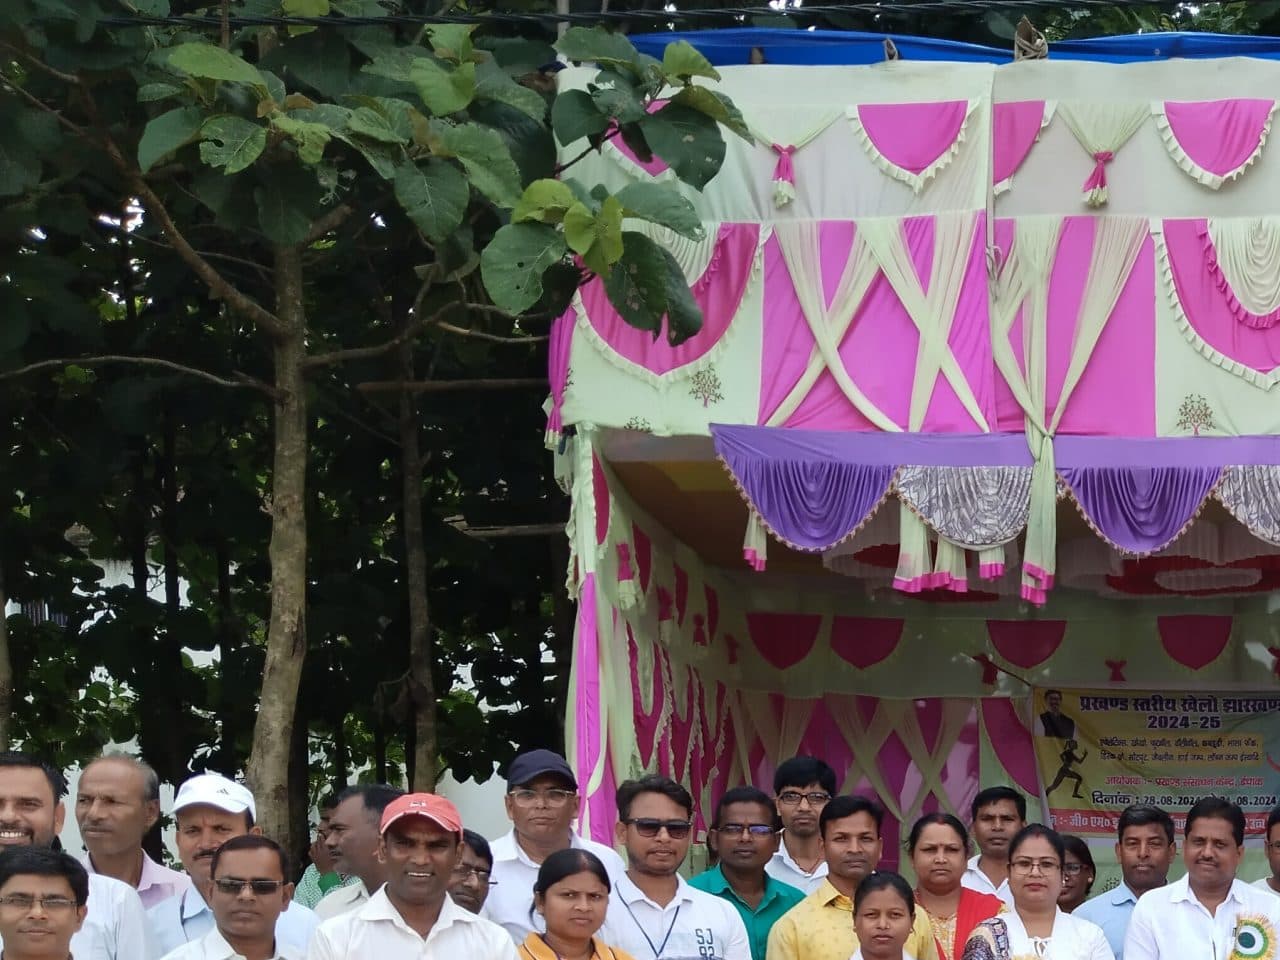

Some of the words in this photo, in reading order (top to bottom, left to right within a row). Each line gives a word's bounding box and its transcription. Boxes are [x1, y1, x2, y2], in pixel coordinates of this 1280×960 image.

[1080, 696, 1129, 711] प्रखण्ड
[1133, 695, 1177, 711] स्तरीय
[1180, 695, 1218, 712] खेलो
[1147, 716, 1220, 729] 2024-25
[1091, 790, 1134, 805] दिनांक
[695, 928, 713, 945] SJ
